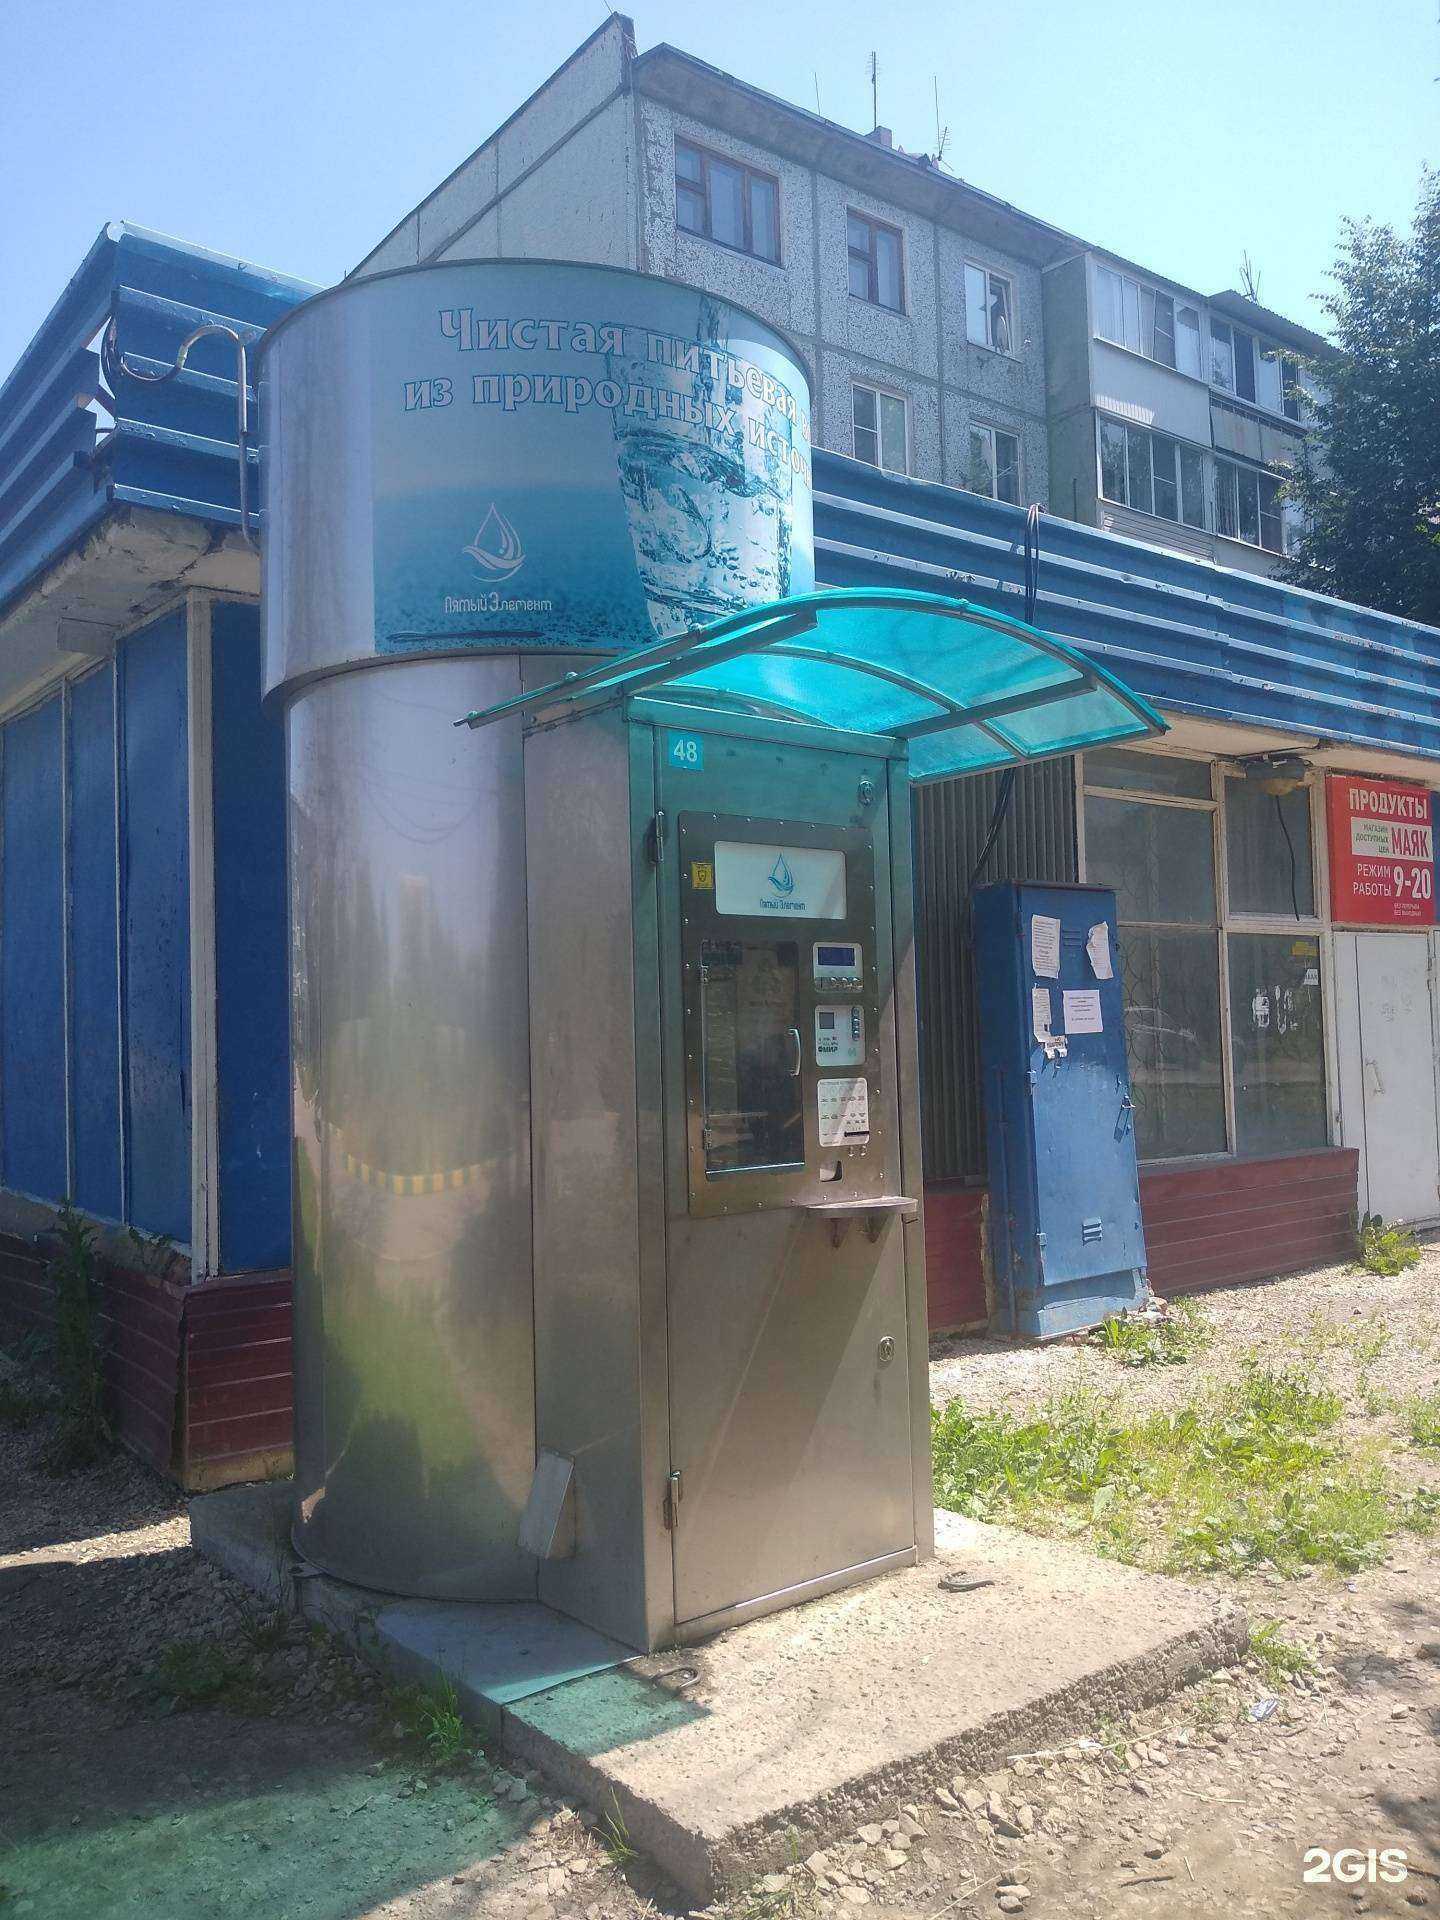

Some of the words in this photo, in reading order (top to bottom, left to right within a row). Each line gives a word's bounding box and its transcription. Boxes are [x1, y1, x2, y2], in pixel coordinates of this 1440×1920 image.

[438, 308, 625, 357] Чистая
[646, 332, 797, 427] питьевая
[404, 377, 453, 411] из
[473, 373, 736, 436] природных
[673, 739, 698, 763] 48
[1349, 788, 1428, 819] ПРОДУКТЫ
[1391, 827, 1429, 858] МАЯК
[1353, 881, 1391, 897] РАБОТЫ
[1357, 863, 1391, 879] РЕЖИМ
[1393, 866, 1432, 899] 9-20
